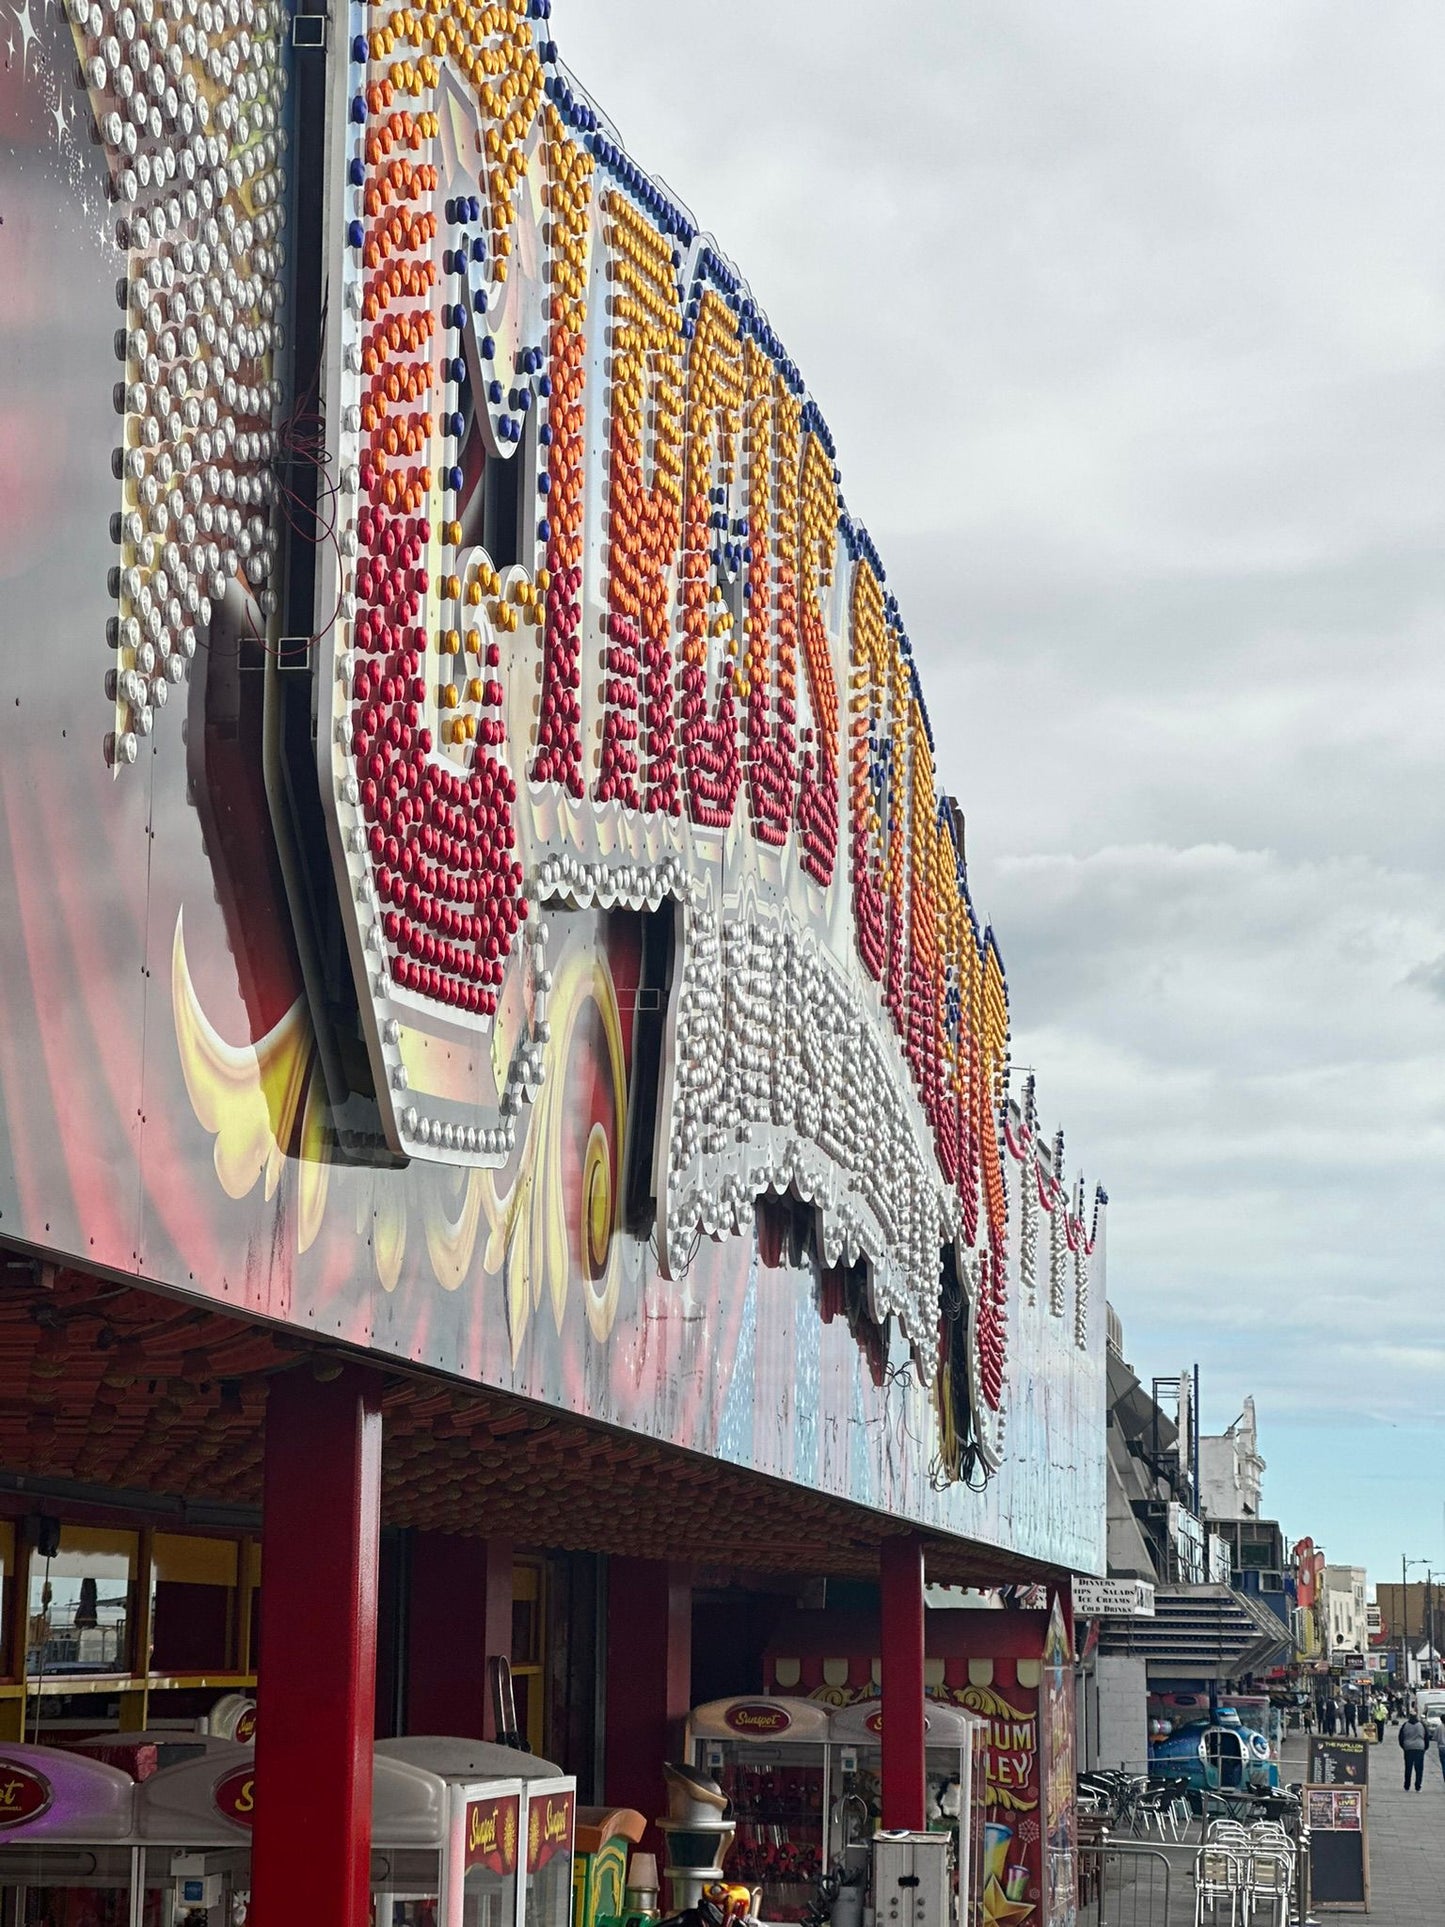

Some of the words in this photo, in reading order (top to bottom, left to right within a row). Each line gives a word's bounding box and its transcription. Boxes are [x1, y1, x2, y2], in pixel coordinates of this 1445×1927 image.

[1096, 1596, 1130, 1604] CREAMS
[1082, 1604, 1101, 1612] COLD
[1104, 1605, 1132, 1613] DRINKS
[735, 1711, 782, 1728] Sunspot
[469, 1806, 499, 1854] Sunspot
